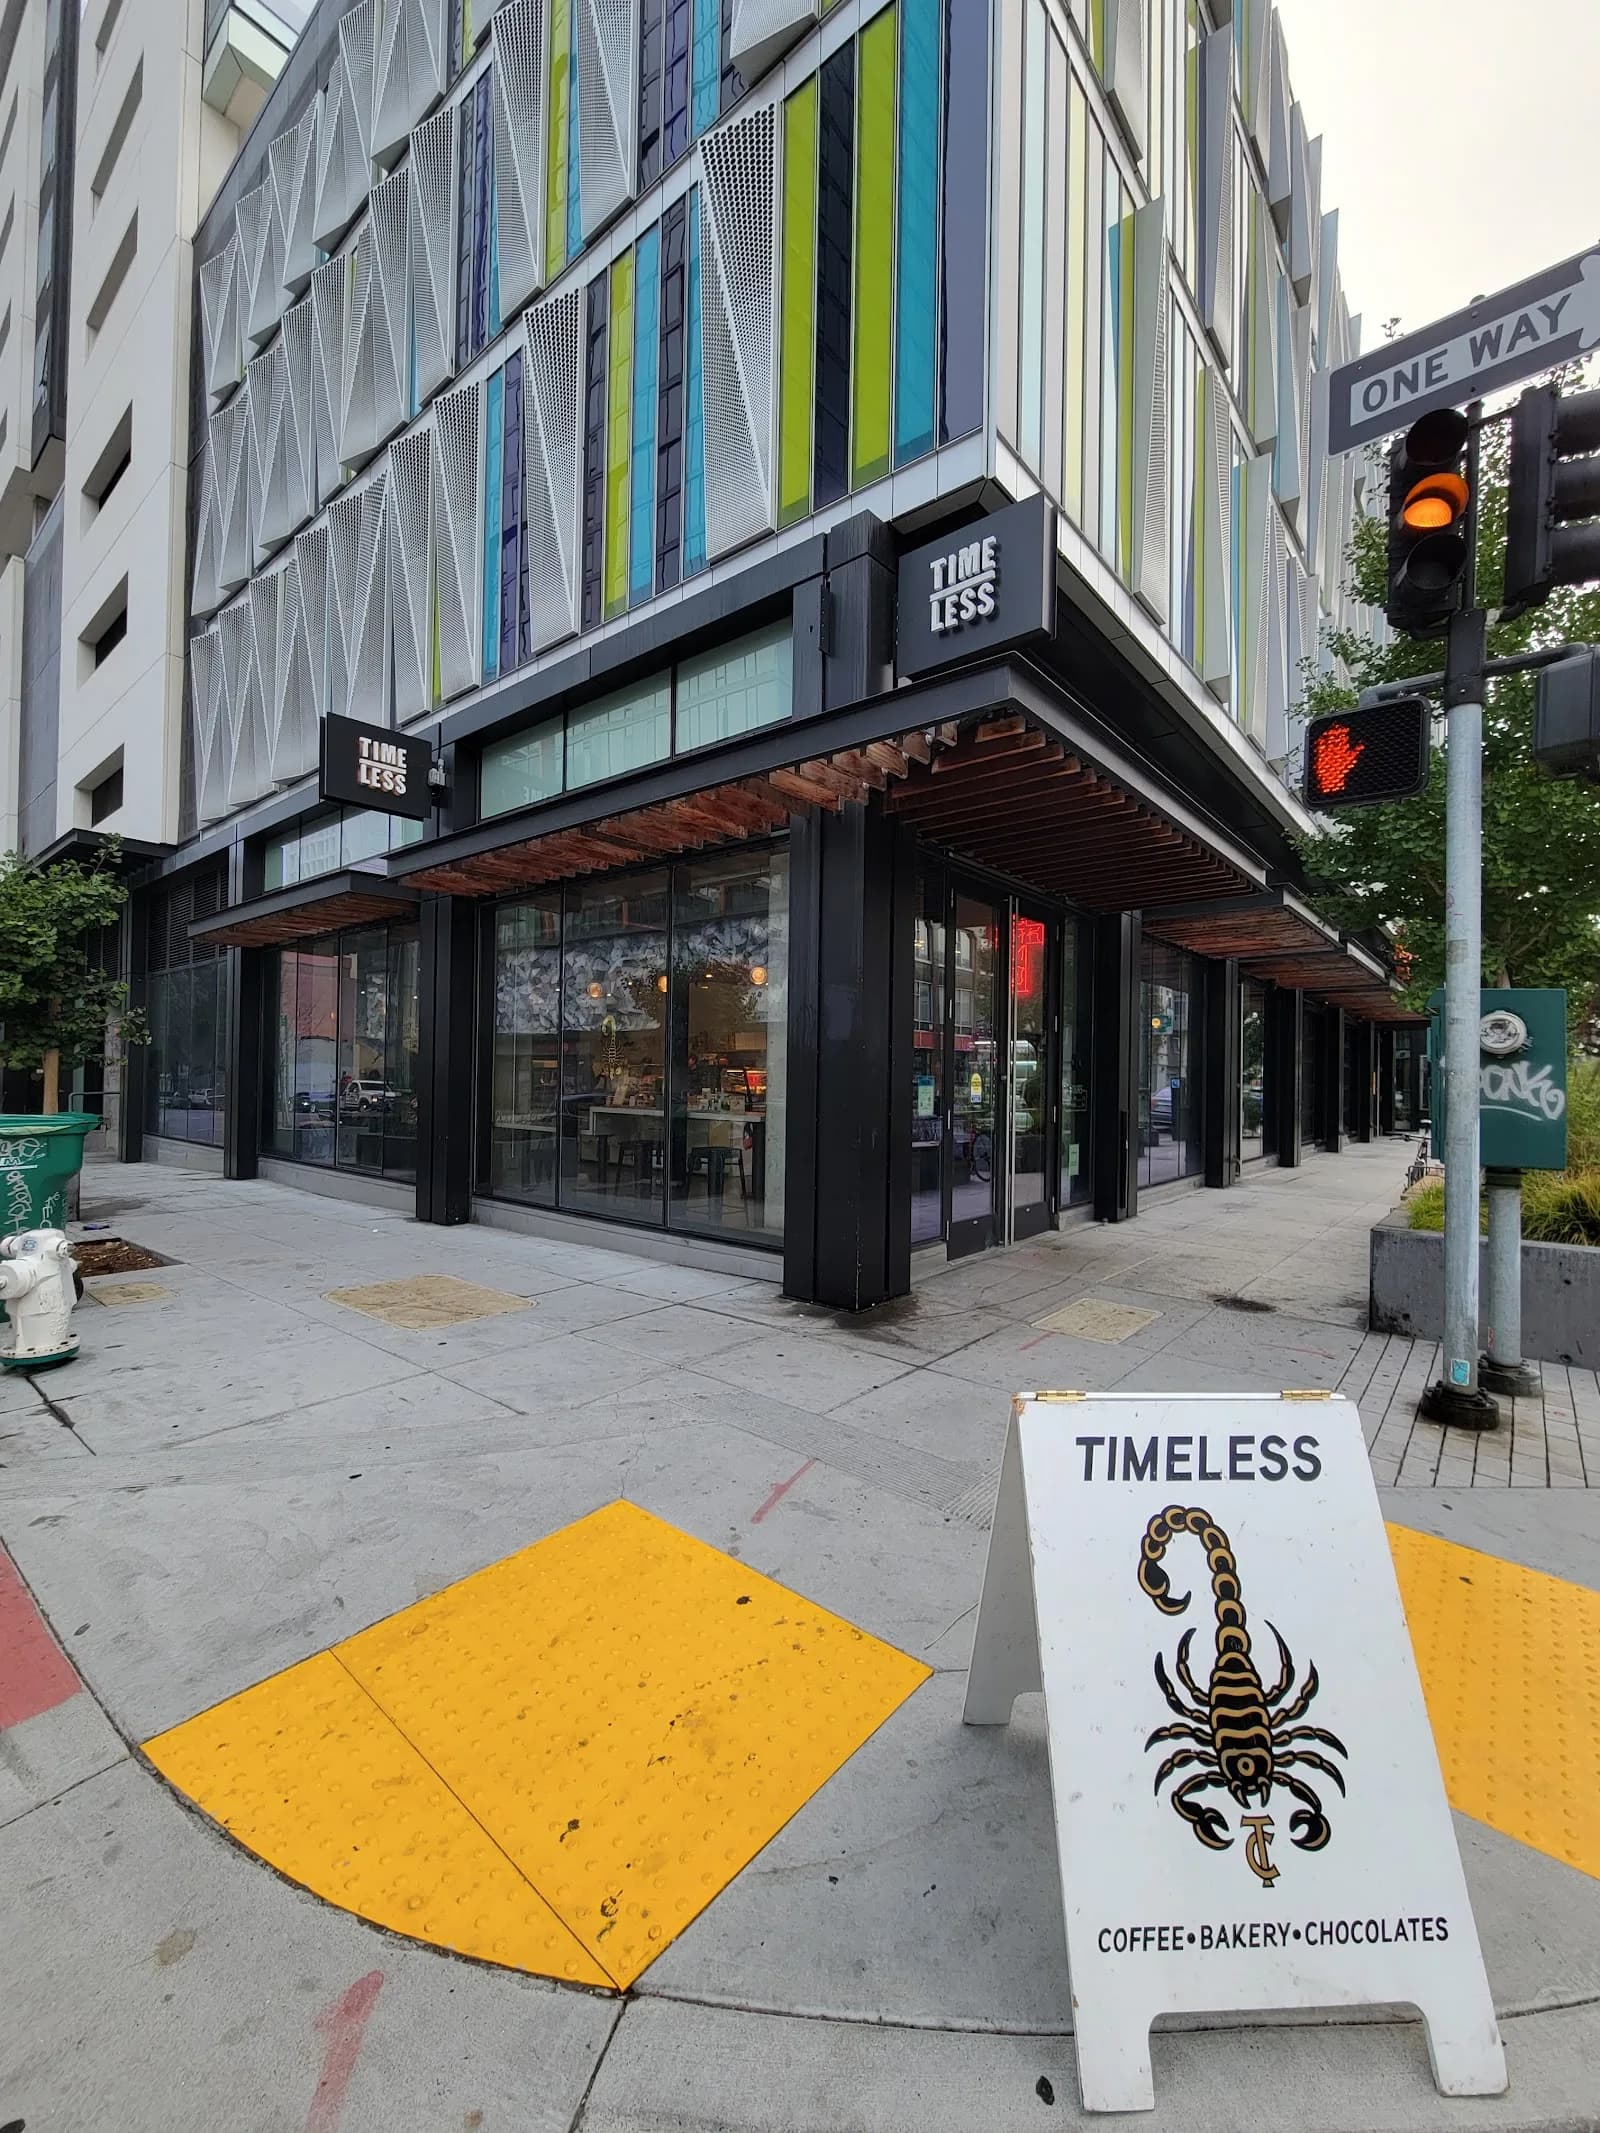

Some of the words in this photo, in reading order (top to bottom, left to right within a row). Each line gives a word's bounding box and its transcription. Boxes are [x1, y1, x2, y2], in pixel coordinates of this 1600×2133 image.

[1362, 349, 1448, 412] ONE
[1469, 293, 1572, 367] WAY
[930, 535, 997, 591] TIME
[931, 582, 995, 632] LESS
[359, 736, 407, 768] TIME
[359, 763, 407, 795] LESS
[1076, 1435, 1322, 1482] TIMELESS
[1098, 1926, 1185, 1952] COFFEE
[1200, 1922, 1291, 1949] BAKERY
[1305, 1917, 1449, 1946] CHOCOLATES
